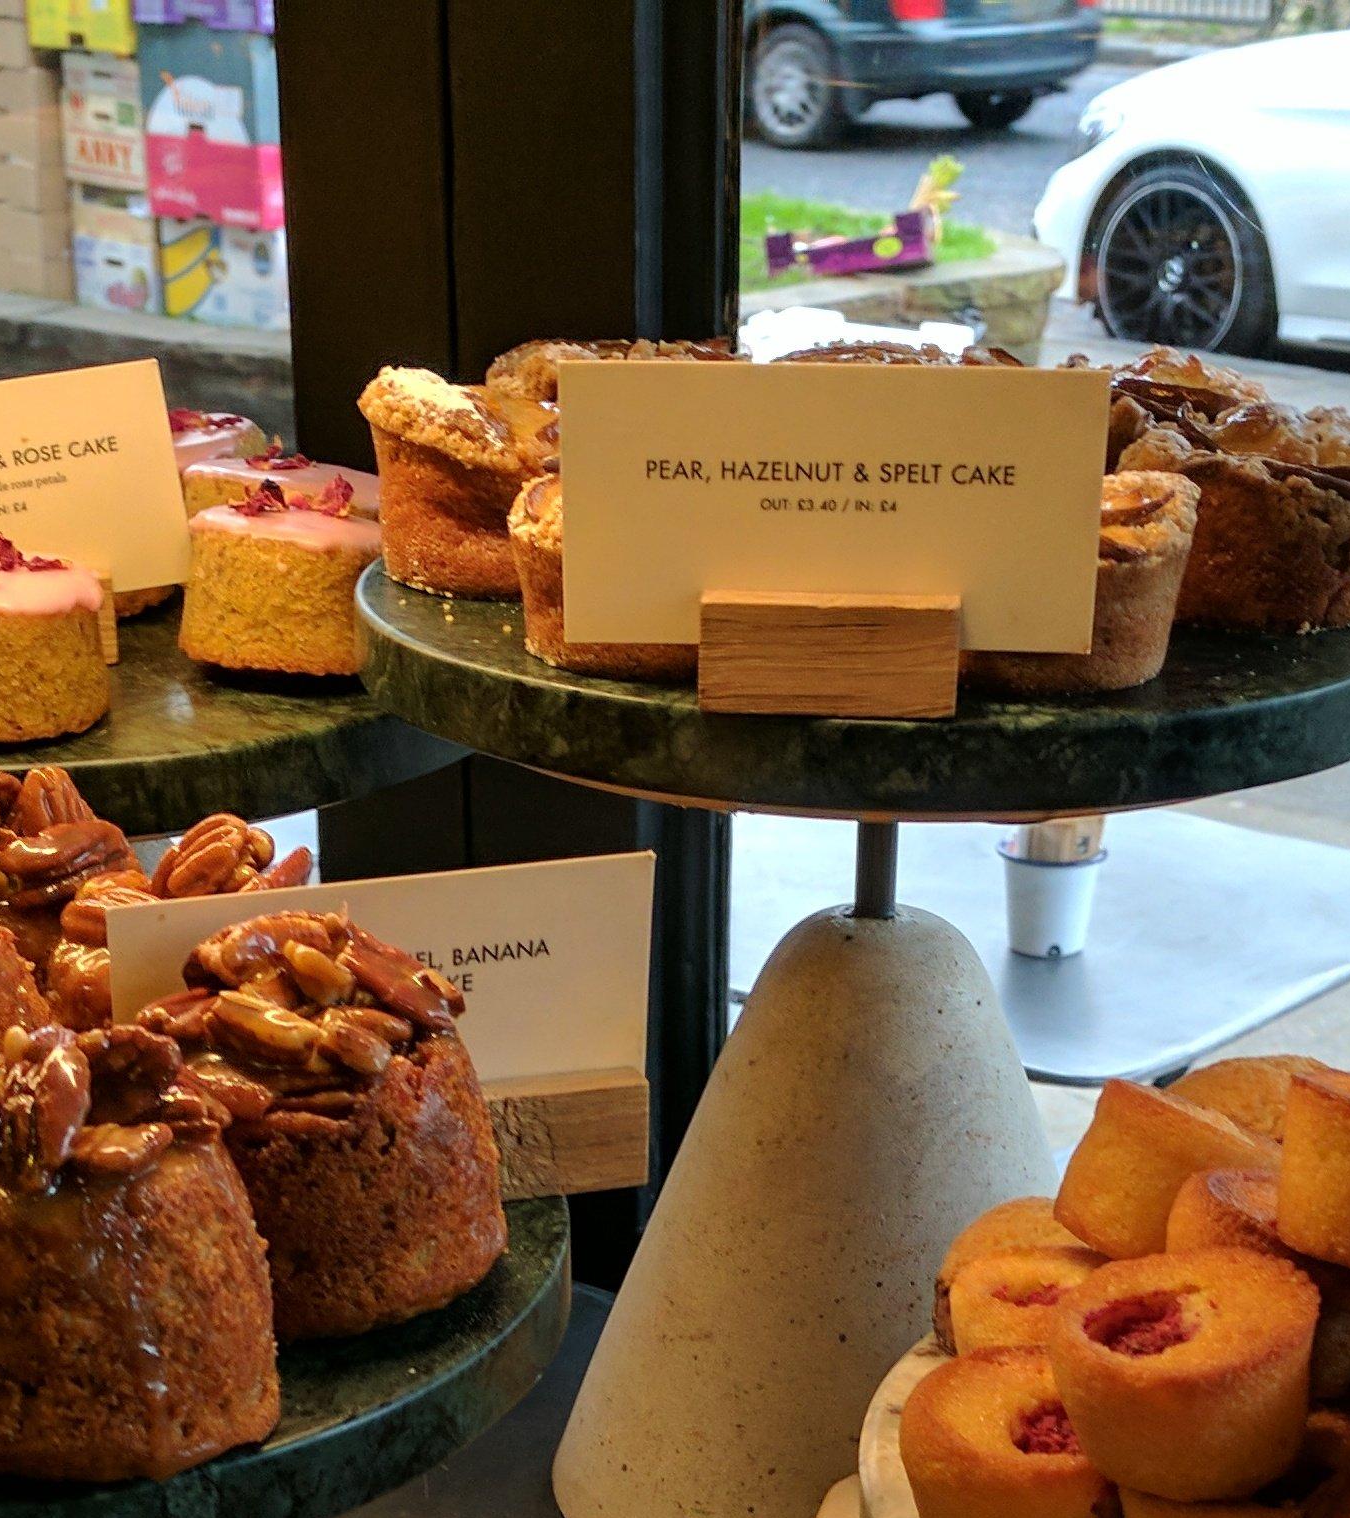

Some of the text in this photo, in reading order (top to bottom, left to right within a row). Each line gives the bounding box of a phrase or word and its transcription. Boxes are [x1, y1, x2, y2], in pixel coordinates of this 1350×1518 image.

[12, 444, 62, 466] ROSE
[68, 435, 118, 457] CAKE
[11, 480, 33, 491] rose
[35, 471, 67, 489] petals
[646, 459, 1015, 486] PEAR, HAZELNUT & SPELT CAKE
[13, 502, 27, 513] £4
[760, 498, 791, 511] OUT:
[798, 498, 837, 512] £3.40
[855, 499, 874, 512] IN:
[880, 499, 897, 512] £4
[452, 939, 550, 967] BANANA
